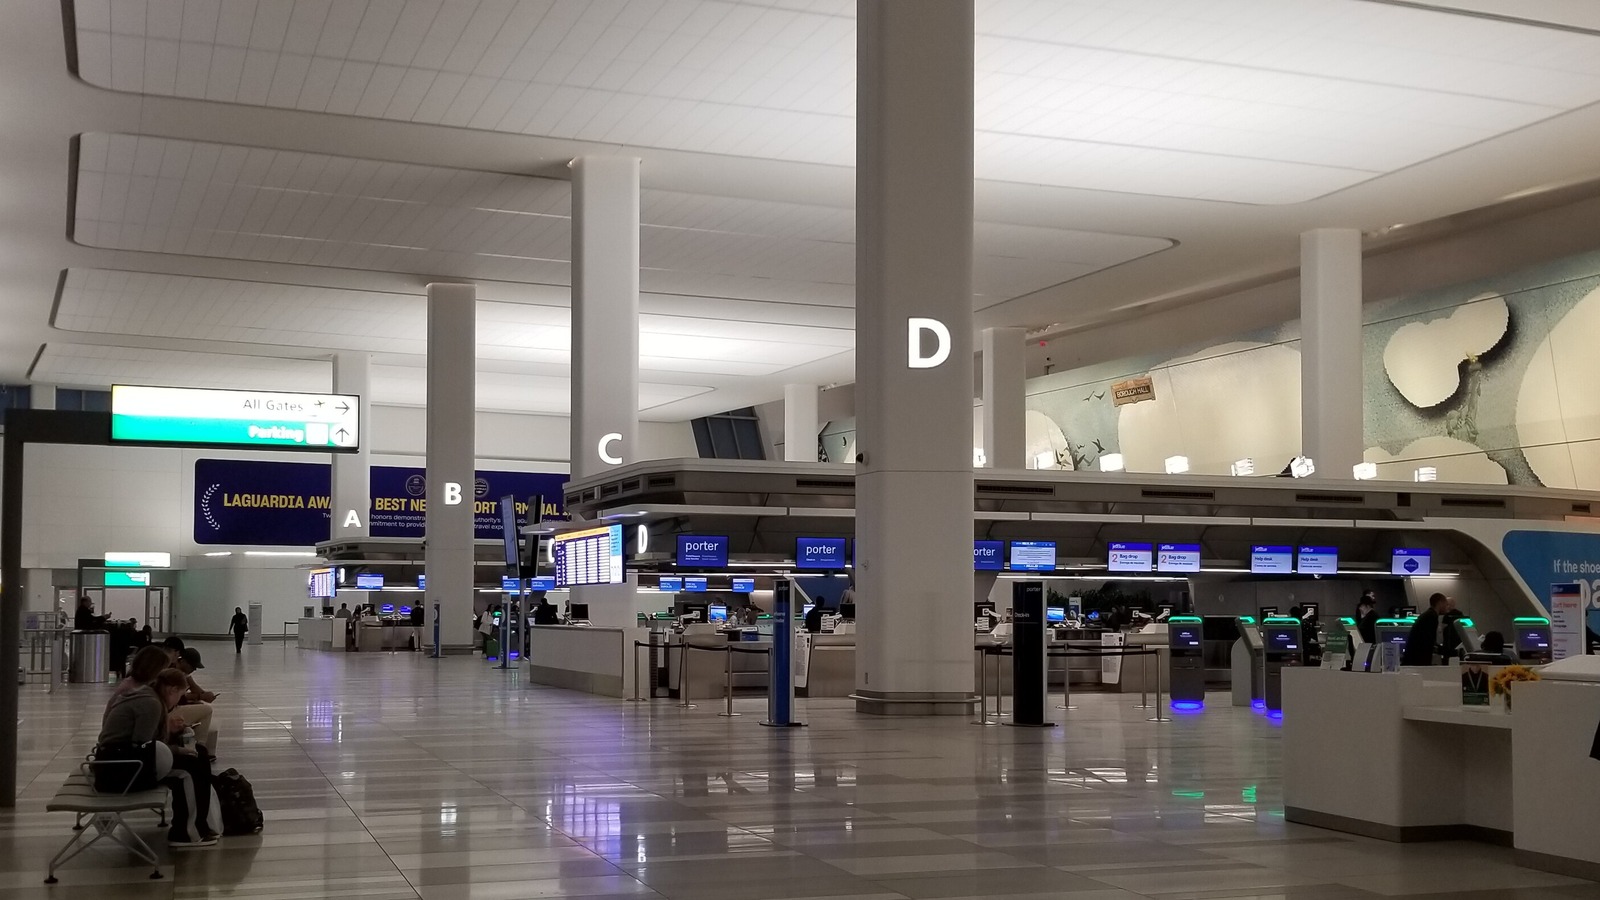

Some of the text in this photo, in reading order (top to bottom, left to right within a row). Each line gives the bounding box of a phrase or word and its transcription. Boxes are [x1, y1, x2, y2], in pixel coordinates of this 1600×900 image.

[907, 317, 951, 369] D
[243, 399, 303, 411] All Gates
[597, 432, 623, 465] C
[444, 482, 463, 505] B
[223, 493, 305, 509] LAGUARDIA
[375, 497, 407, 511] BEST
[410, 498, 426, 512] NE
[343, 509, 362, 528] A
[638, 524, 648, 554] D
[685, 541, 719, 553] porter
[806, 545, 836, 556] porter
[974, 547, 996, 557] orter
[1112, 553, 1118, 563] 2
[1161, 554, 1167, 564] 2
[1553, 559, 1600, 574] If the shoe
